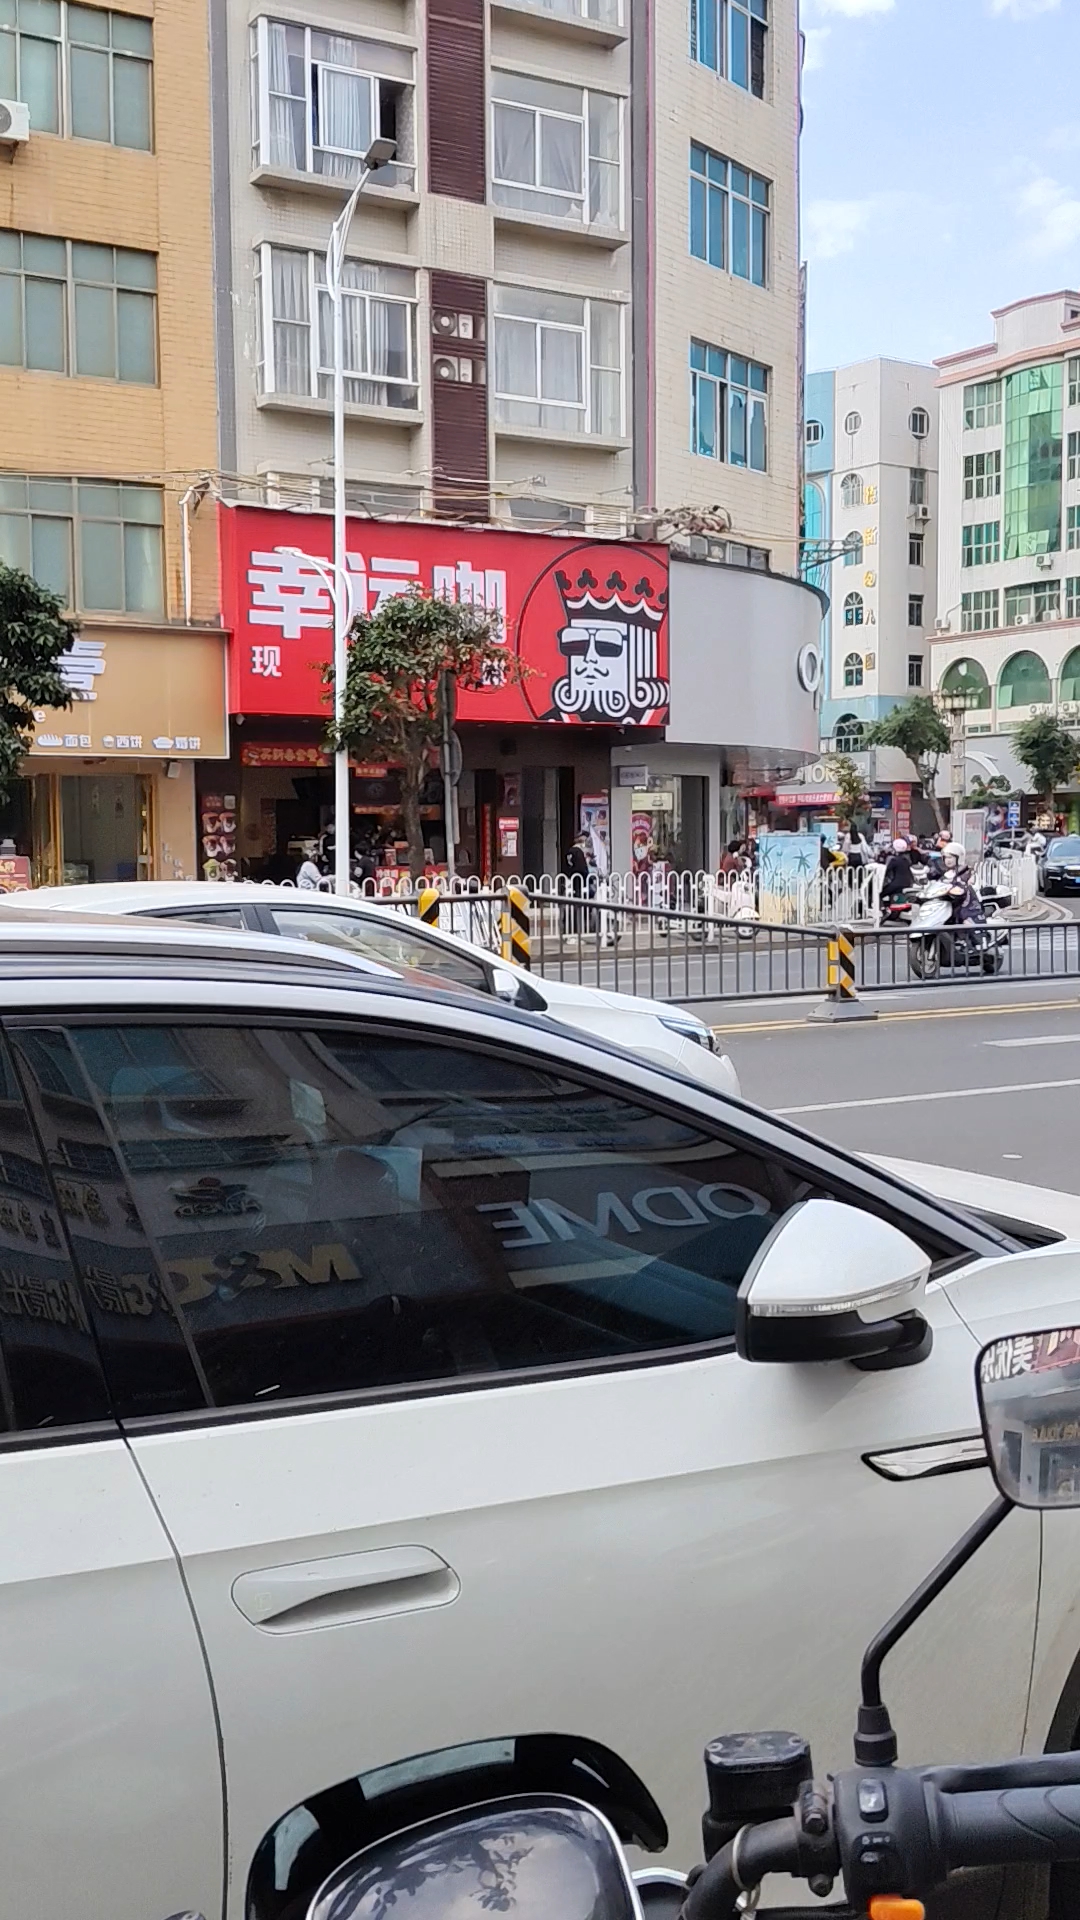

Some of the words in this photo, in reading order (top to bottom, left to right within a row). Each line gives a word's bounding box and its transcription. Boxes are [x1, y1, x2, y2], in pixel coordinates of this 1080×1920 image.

[251, 645, 282, 678] 现
[64, 734, 92, 748] 面包
[116, 735, 143, 749] 西饼
